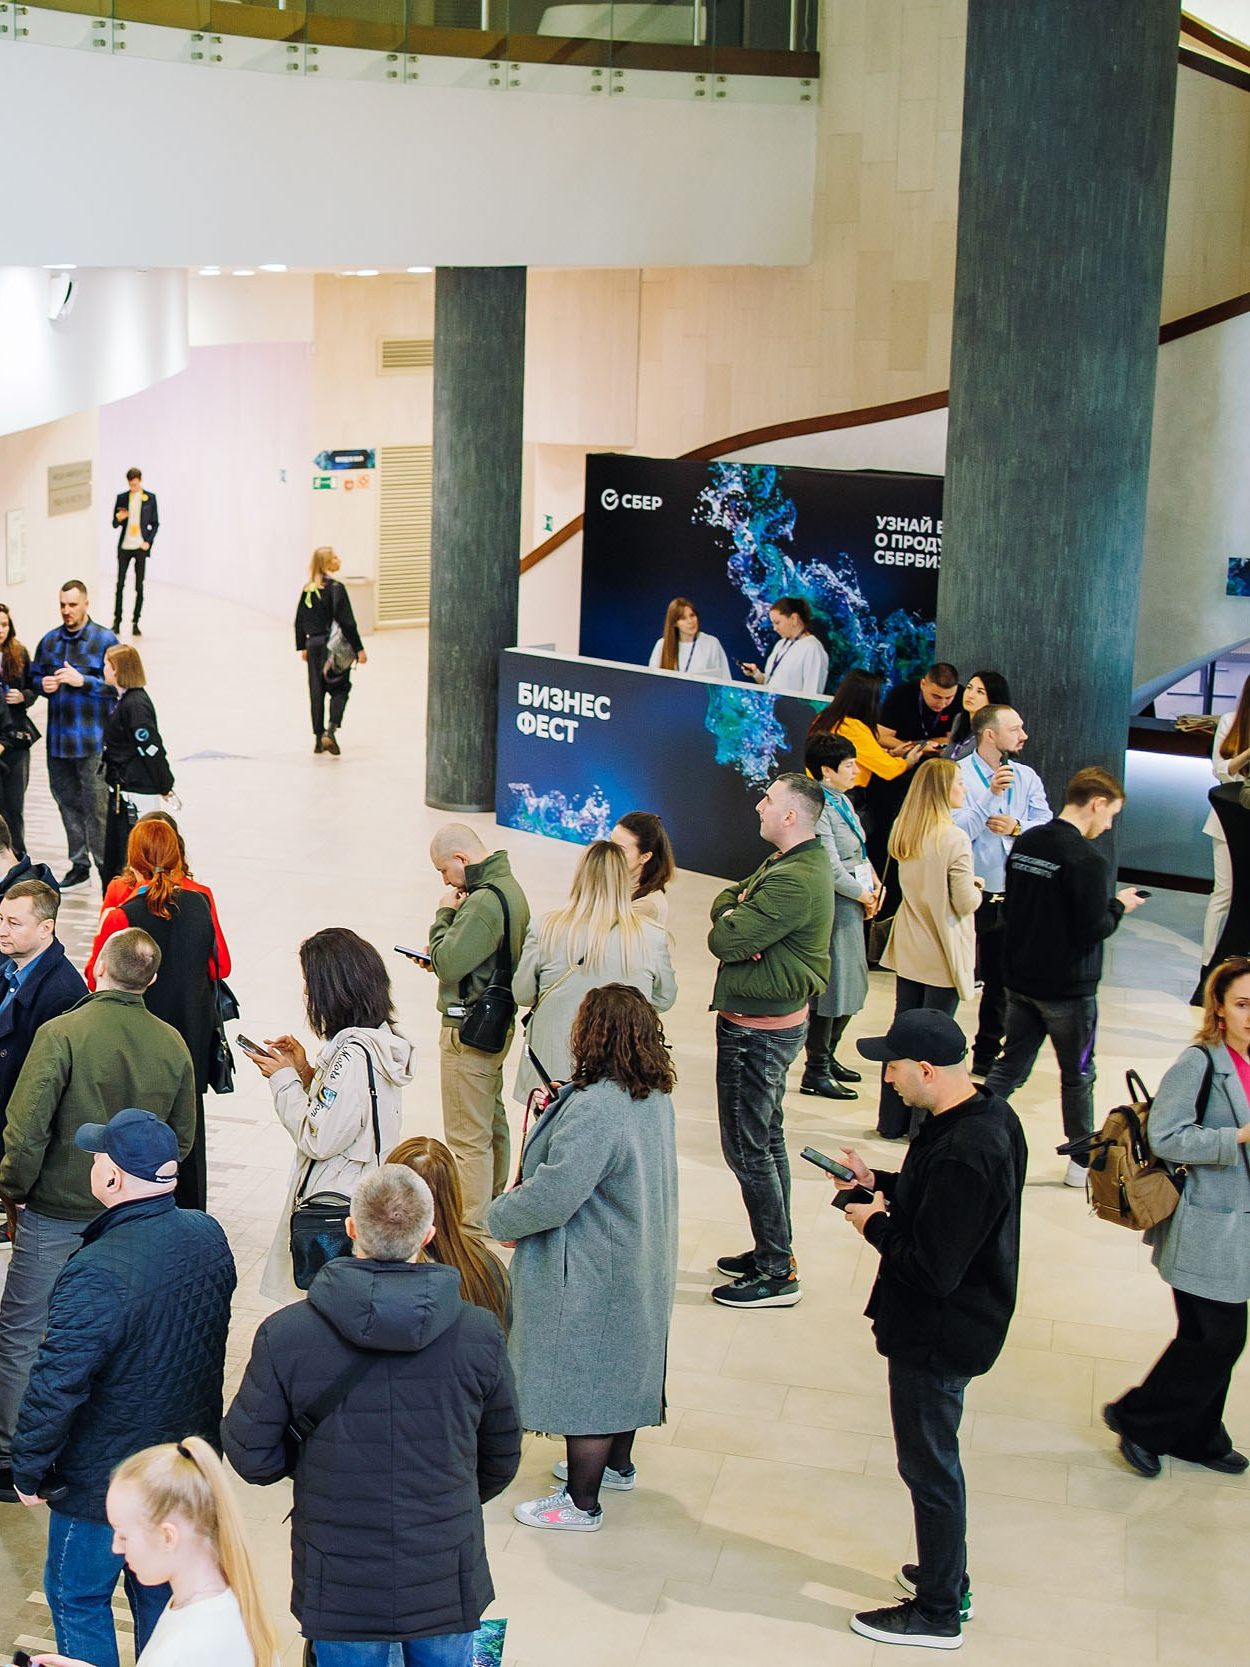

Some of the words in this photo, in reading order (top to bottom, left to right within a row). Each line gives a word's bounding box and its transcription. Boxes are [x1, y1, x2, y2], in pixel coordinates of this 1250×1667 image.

[621, 494, 663, 511] СБЕР
[875, 515, 933, 534] УЗНАЙ
[874, 532, 888, 547] О
[873, 549, 941, 569] СБЕРБИ
[517, 681, 612, 721] БИЗНЕС
[516, 710, 579, 743] ФЕСТ
